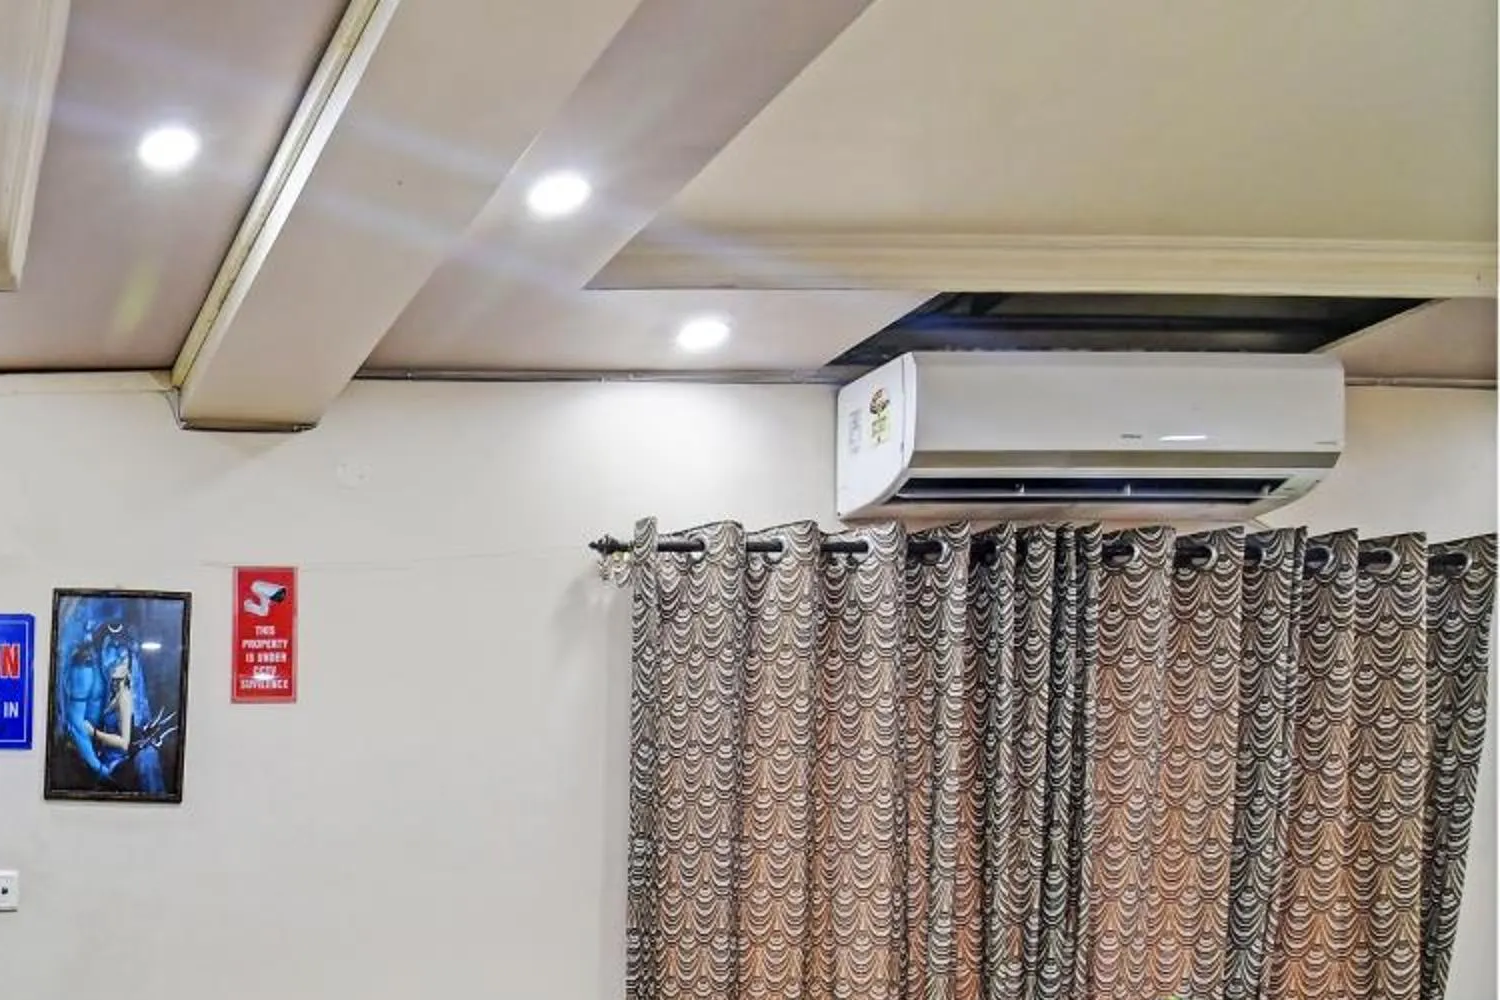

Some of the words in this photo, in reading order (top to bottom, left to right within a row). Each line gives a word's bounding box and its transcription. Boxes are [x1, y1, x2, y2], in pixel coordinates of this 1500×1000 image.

[255, 625, 276, 636] THIS
[241, 639, 289, 649] PROPERTY
[245, 652, 255, 663] IS
[257, 652, 287, 663] UNDER
[3, 701, 20, 719] IN
